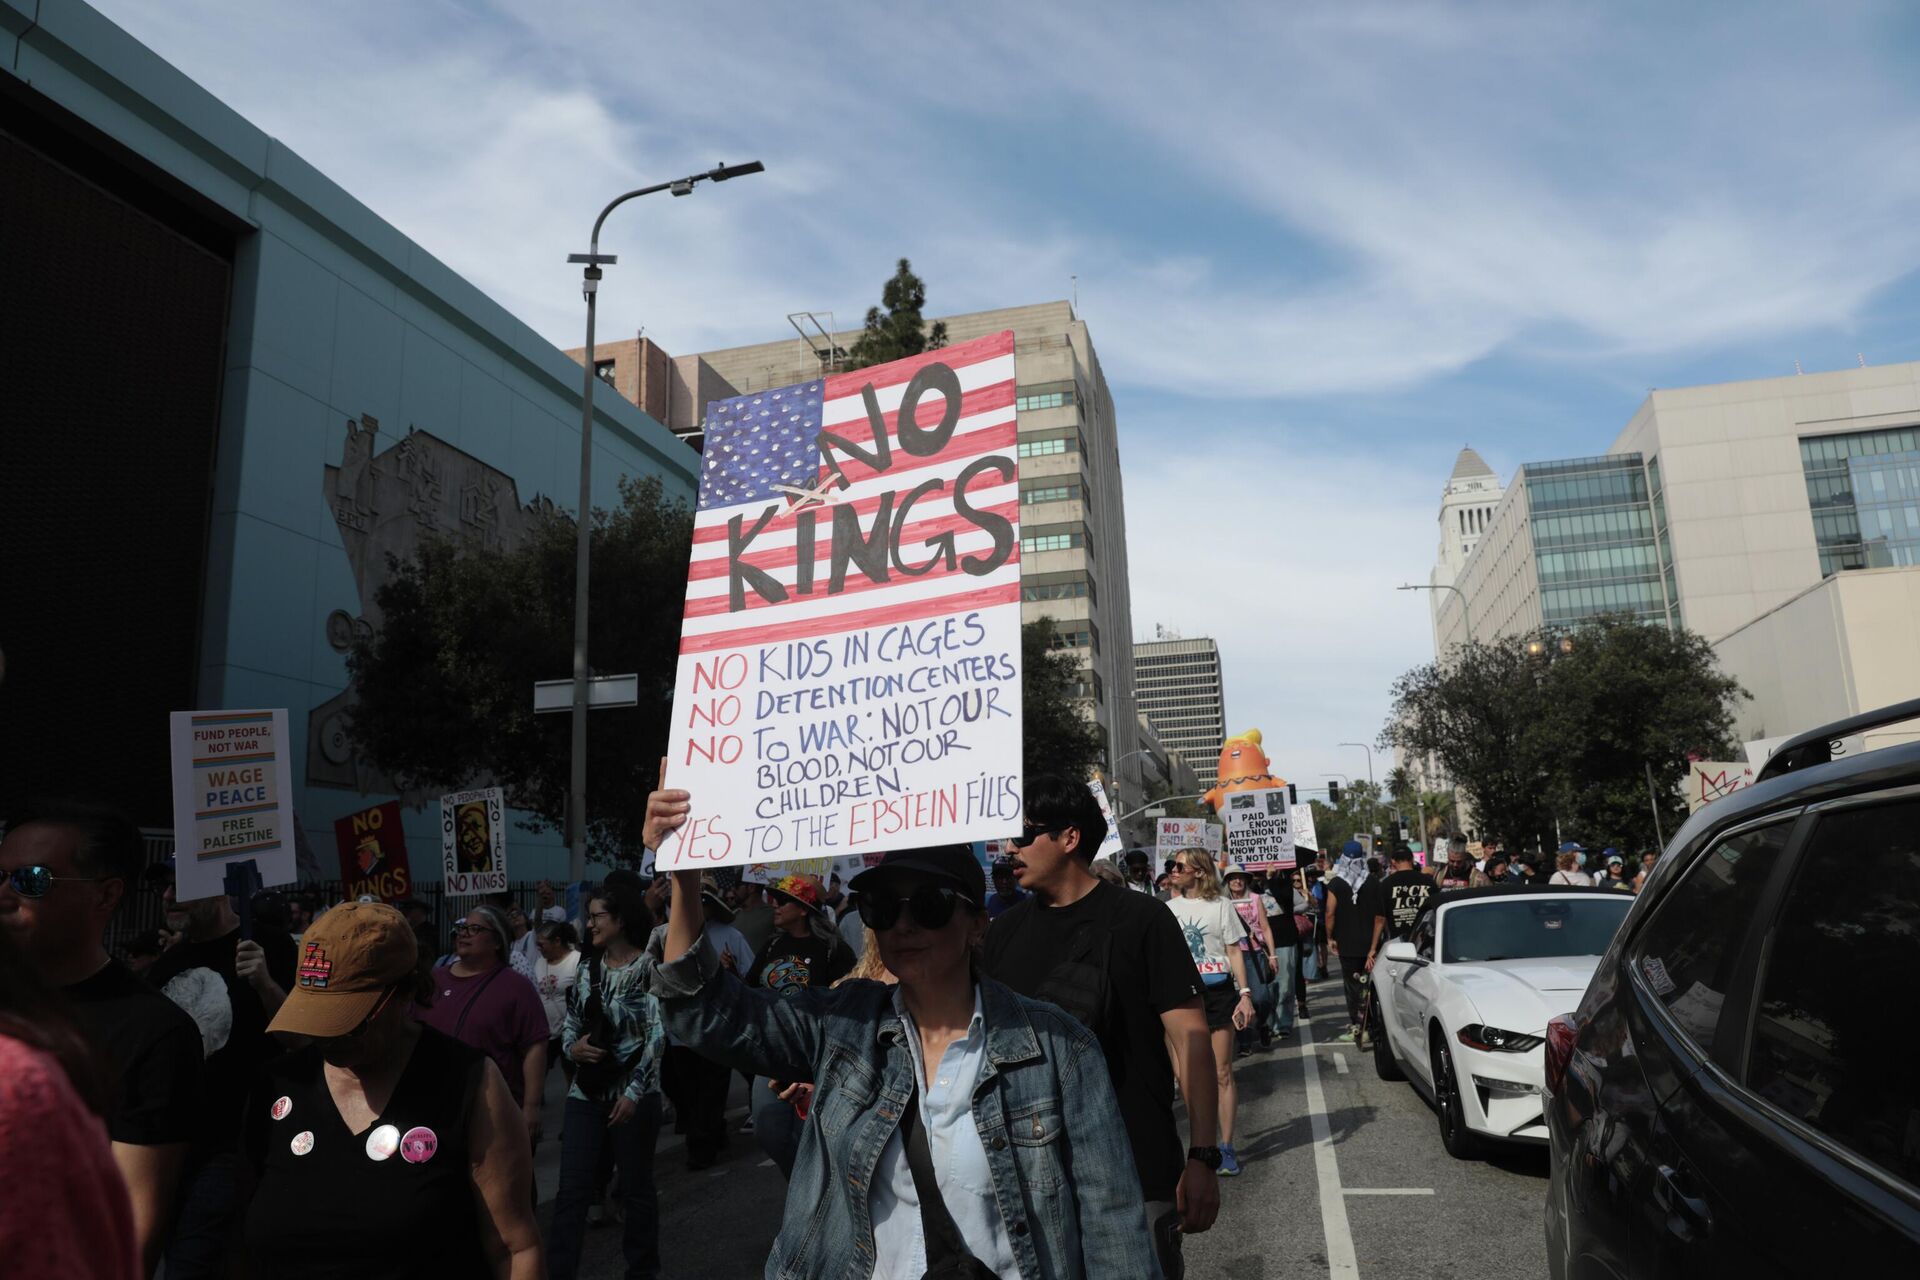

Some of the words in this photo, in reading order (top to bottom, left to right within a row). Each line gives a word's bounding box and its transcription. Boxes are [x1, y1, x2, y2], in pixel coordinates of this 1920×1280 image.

[815, 361, 962, 491] NO
[728, 455, 1015, 612] KINGS
[692, 653, 748, 694] NO
[759, 640, 832, 683] KIDS
[843, 631, 869, 668] IN
[877, 613, 985, 662] CAGES
[689, 694, 741, 729] NO
[756, 674, 904, 720] DETENTION
[907, 653, 1016, 693] CENTERS
[194, 730, 225, 741] FUND
[685, 735, 743, 766] NO
[881, 697, 934, 739] NOT
[939, 687, 1012, 726] OUR
[208, 743, 231, 753] NOT
[235, 740, 258, 751] WAR
[848, 741, 896, 775] NOT
[900, 729, 972, 764] OUR
[208, 768, 264, 788] WAGE
[206, 786, 266, 807] PEACE
[756, 767, 910, 819] CHILDREN.
[222, 817, 254, 832] FREE
[352, 808, 384, 835] NO
[671, 815, 731, 863] YES
[744, 824, 783, 858] TO
[791, 813, 839, 856] THE
[849, 783, 958, 846] EPSTEIN
[1164, 823, 1180, 833] NO
[1229, 815, 1232, 823] I
[1242, 812, 1264, 821] PAID
[1249, 818, 1287, 829] ENOUGH
[203, 828, 273, 849] PALESTINE
[1160, 835, 1204, 847] ENDLESS
[1229, 828, 1274, 839] ATTENION
[1230, 837, 1267, 847] HISTORY
[1229, 846, 1255, 855] KNOW
[1258, 845, 1279, 854] THIS
[1246, 854, 1263, 862] NOT
[350, 867, 407, 901] KINGS
[447, 875, 467, 893] NO
[472, 872, 506, 890] KINGS
